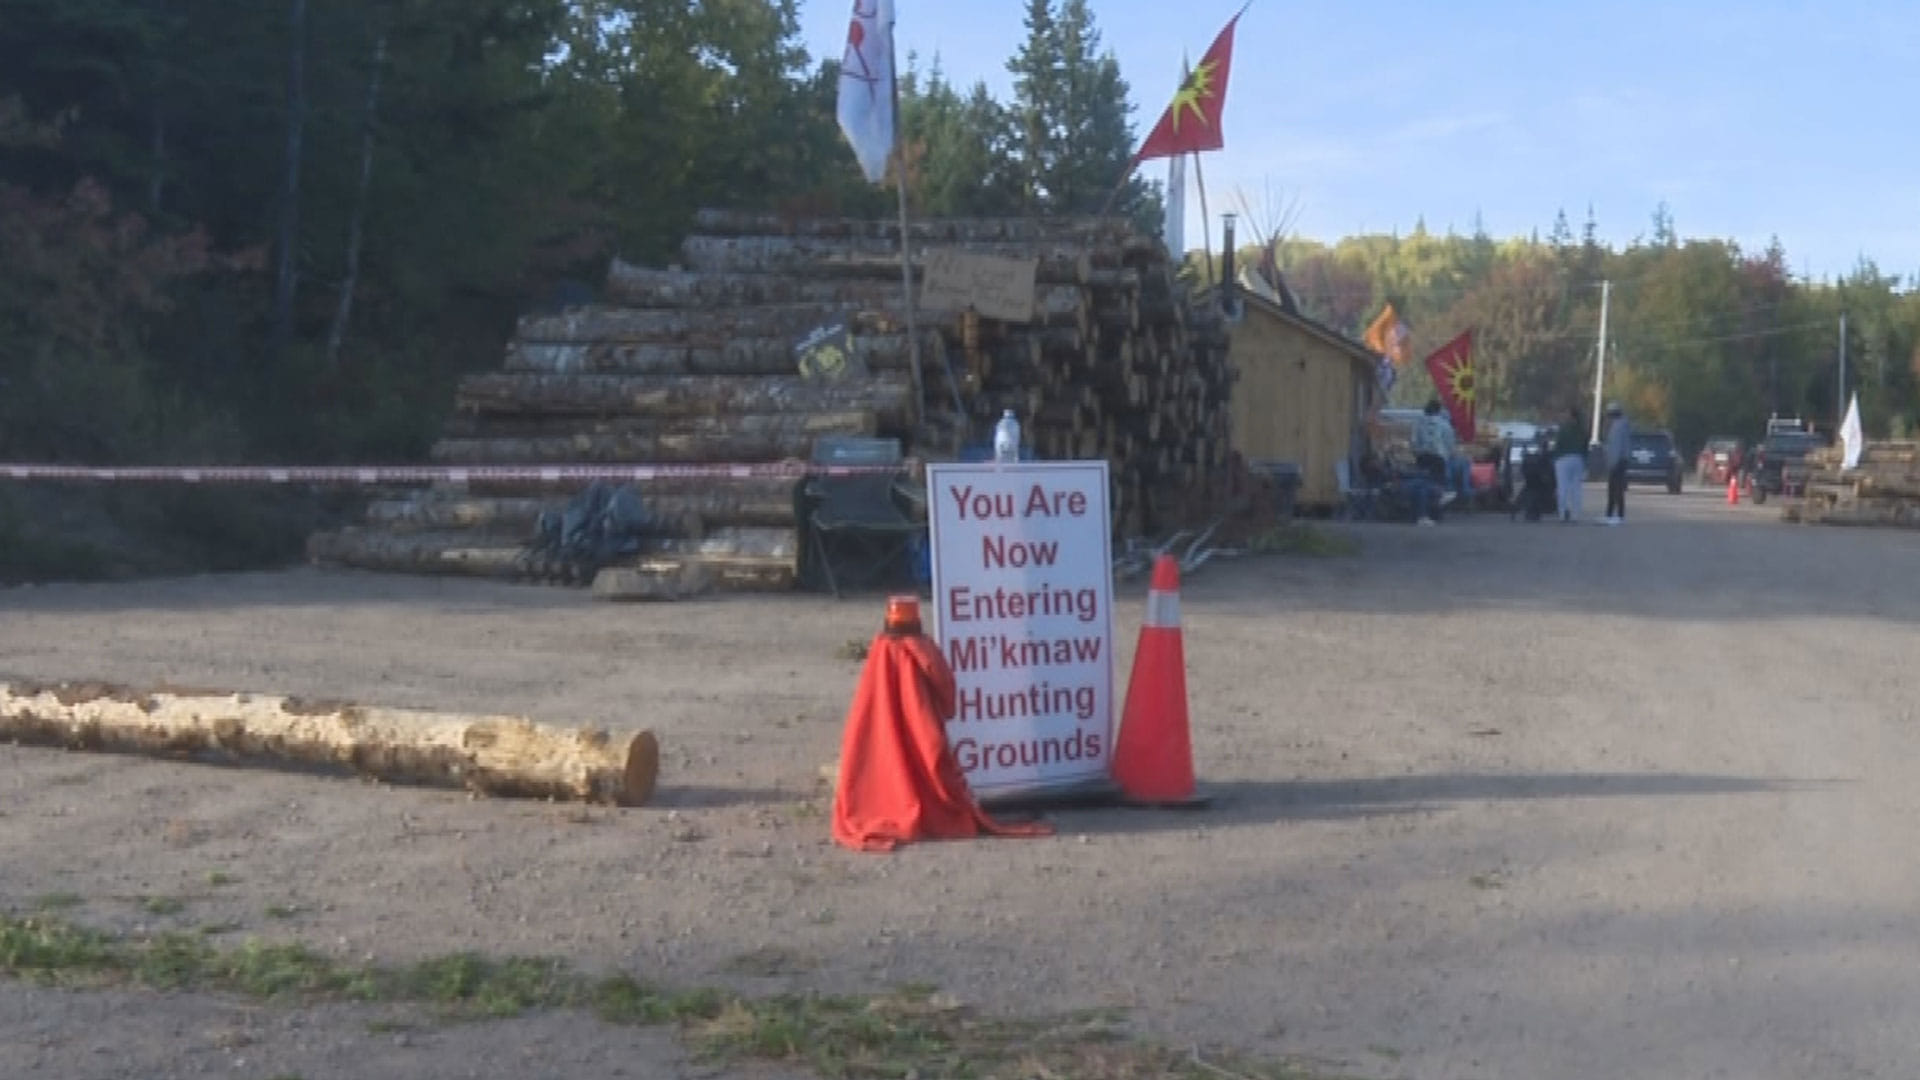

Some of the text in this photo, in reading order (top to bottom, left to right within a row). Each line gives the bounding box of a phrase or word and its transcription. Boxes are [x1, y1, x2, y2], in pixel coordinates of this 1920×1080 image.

[950, 484, 1087, 520] You Are
[982, 535, 1059, 569] Now
[950, 582, 1097, 622] Entering
[959, 681, 1095, 722] Hunting
[954, 727, 1101, 772] Grounds
